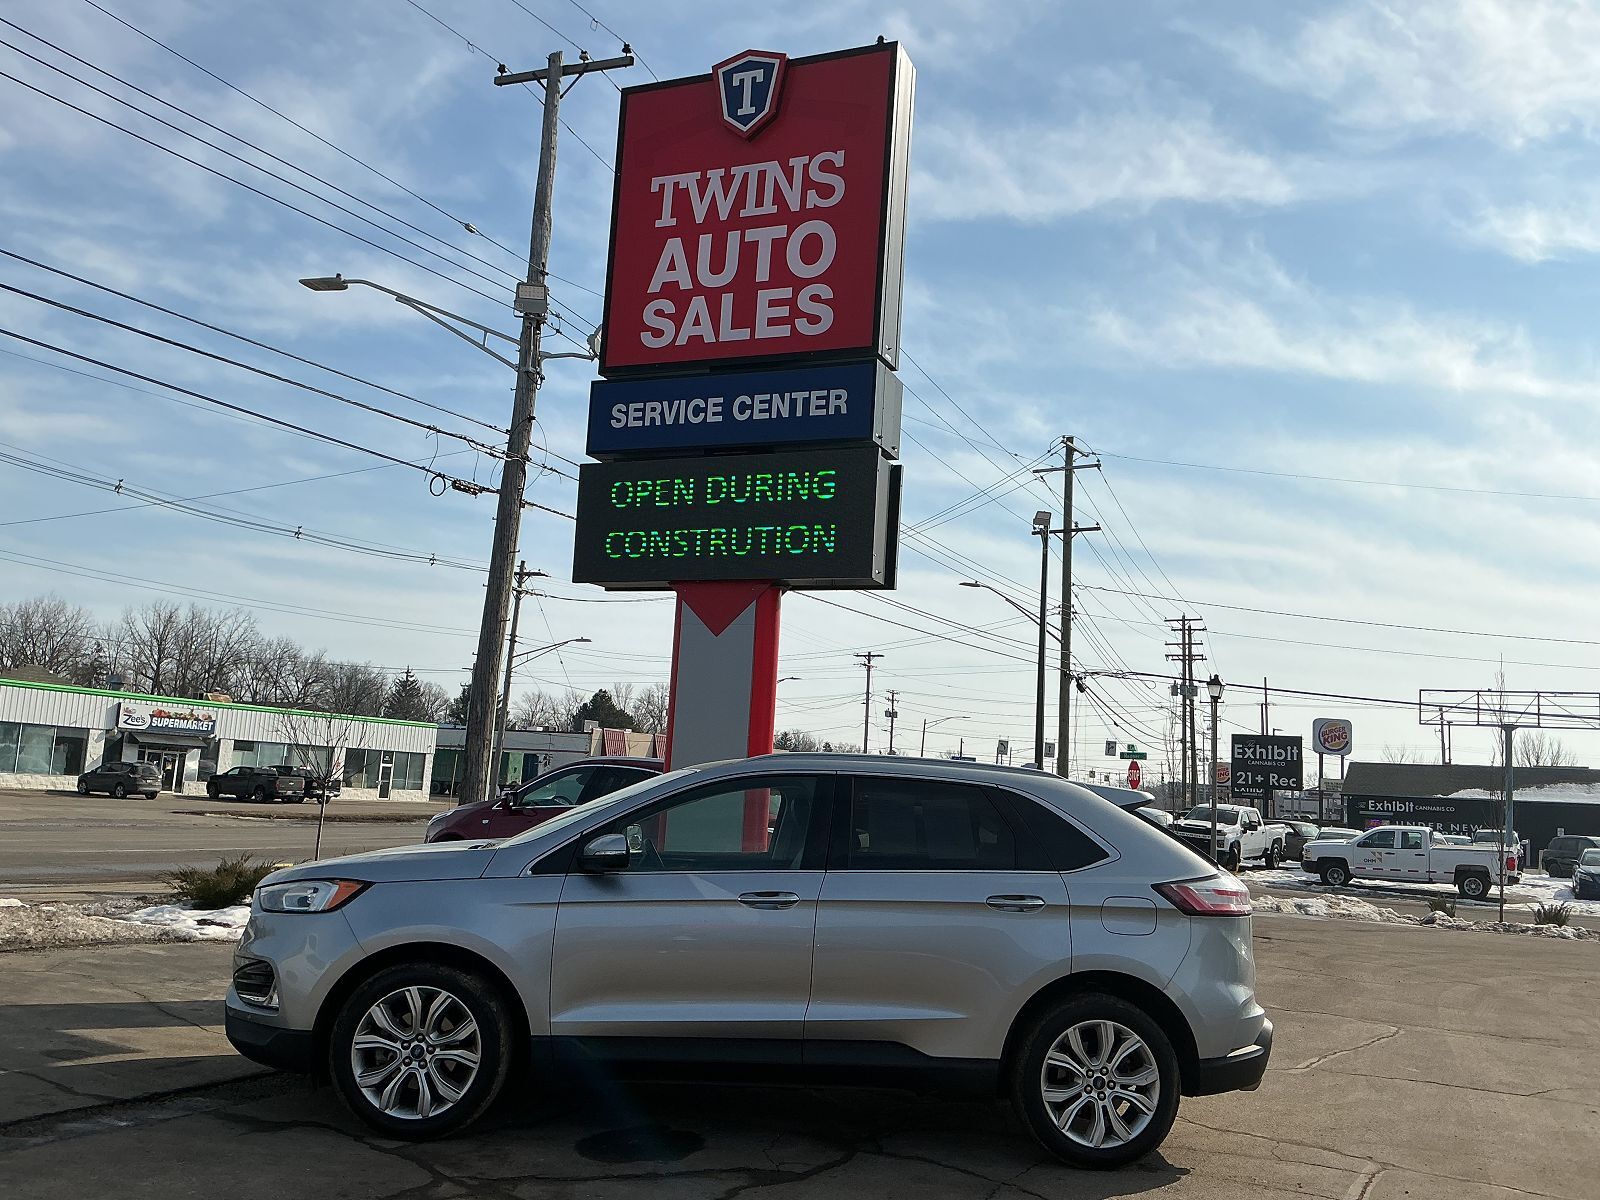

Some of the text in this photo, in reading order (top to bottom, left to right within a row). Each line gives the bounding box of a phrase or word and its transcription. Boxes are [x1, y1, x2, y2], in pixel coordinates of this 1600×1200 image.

[732, 68, 765, 116] T
[650, 150, 846, 228] TWINS
[647, 220, 837, 294] AUTO
[640, 283, 834, 348] SALES
[610, 388, 848, 429] SERVICE CENTER
[611, 470, 837, 508] OPEN DURING
[604, 524, 837, 558] CONSTRUTION
[151, 717, 214, 731] SUPERMARKET
[1321, 726, 1346, 738] BURGER
[1322, 732, 1348, 746] KING
[1129, 769, 1140, 781] STOP
[1236, 771, 1297, 787] 21+ Rec
[1450, 823, 1483, 832] NEW
